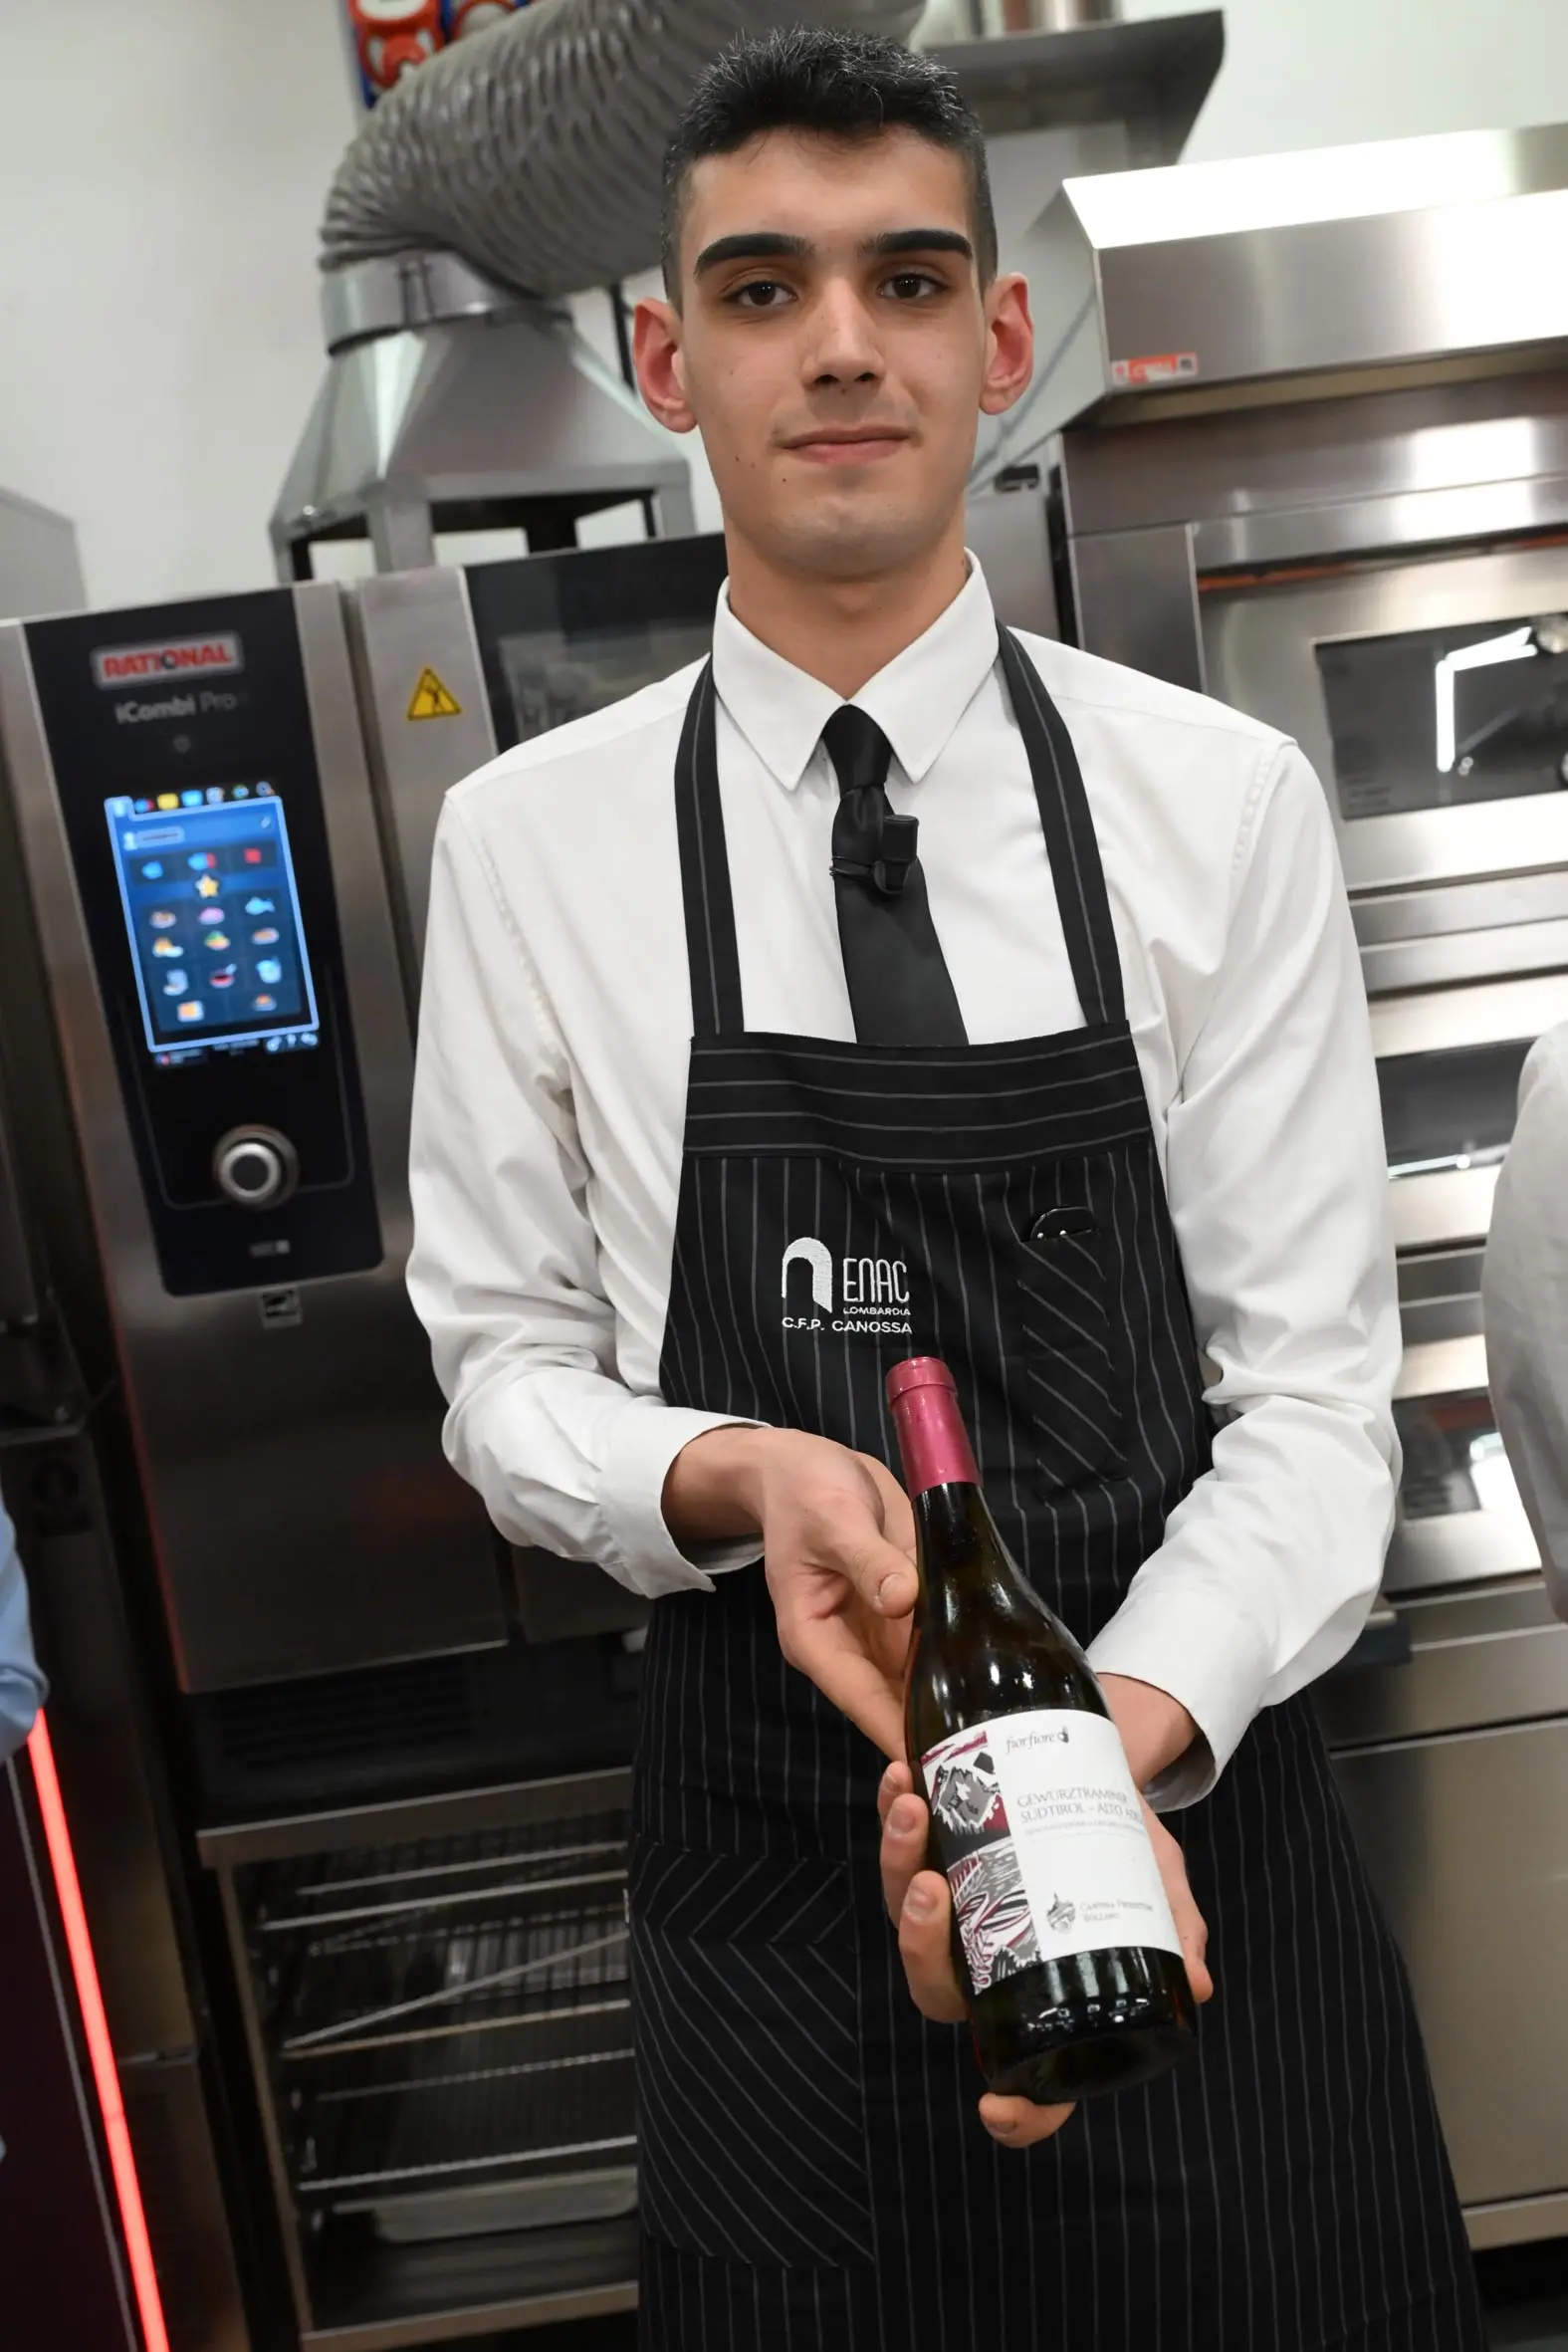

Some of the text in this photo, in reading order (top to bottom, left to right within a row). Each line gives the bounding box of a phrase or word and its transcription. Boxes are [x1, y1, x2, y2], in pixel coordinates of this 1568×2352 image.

[103, 642, 232, 678] RATIONAL
[115, 691, 237, 724] iCombi Pro
[842, 1258, 910, 1303] ENAC
[843, 1305, 912, 1316] LOMBARDIA
[782, 1316, 913, 1335] C.F.P. CANOSSA
[1097, 1802, 1123, 1819] ALTO
